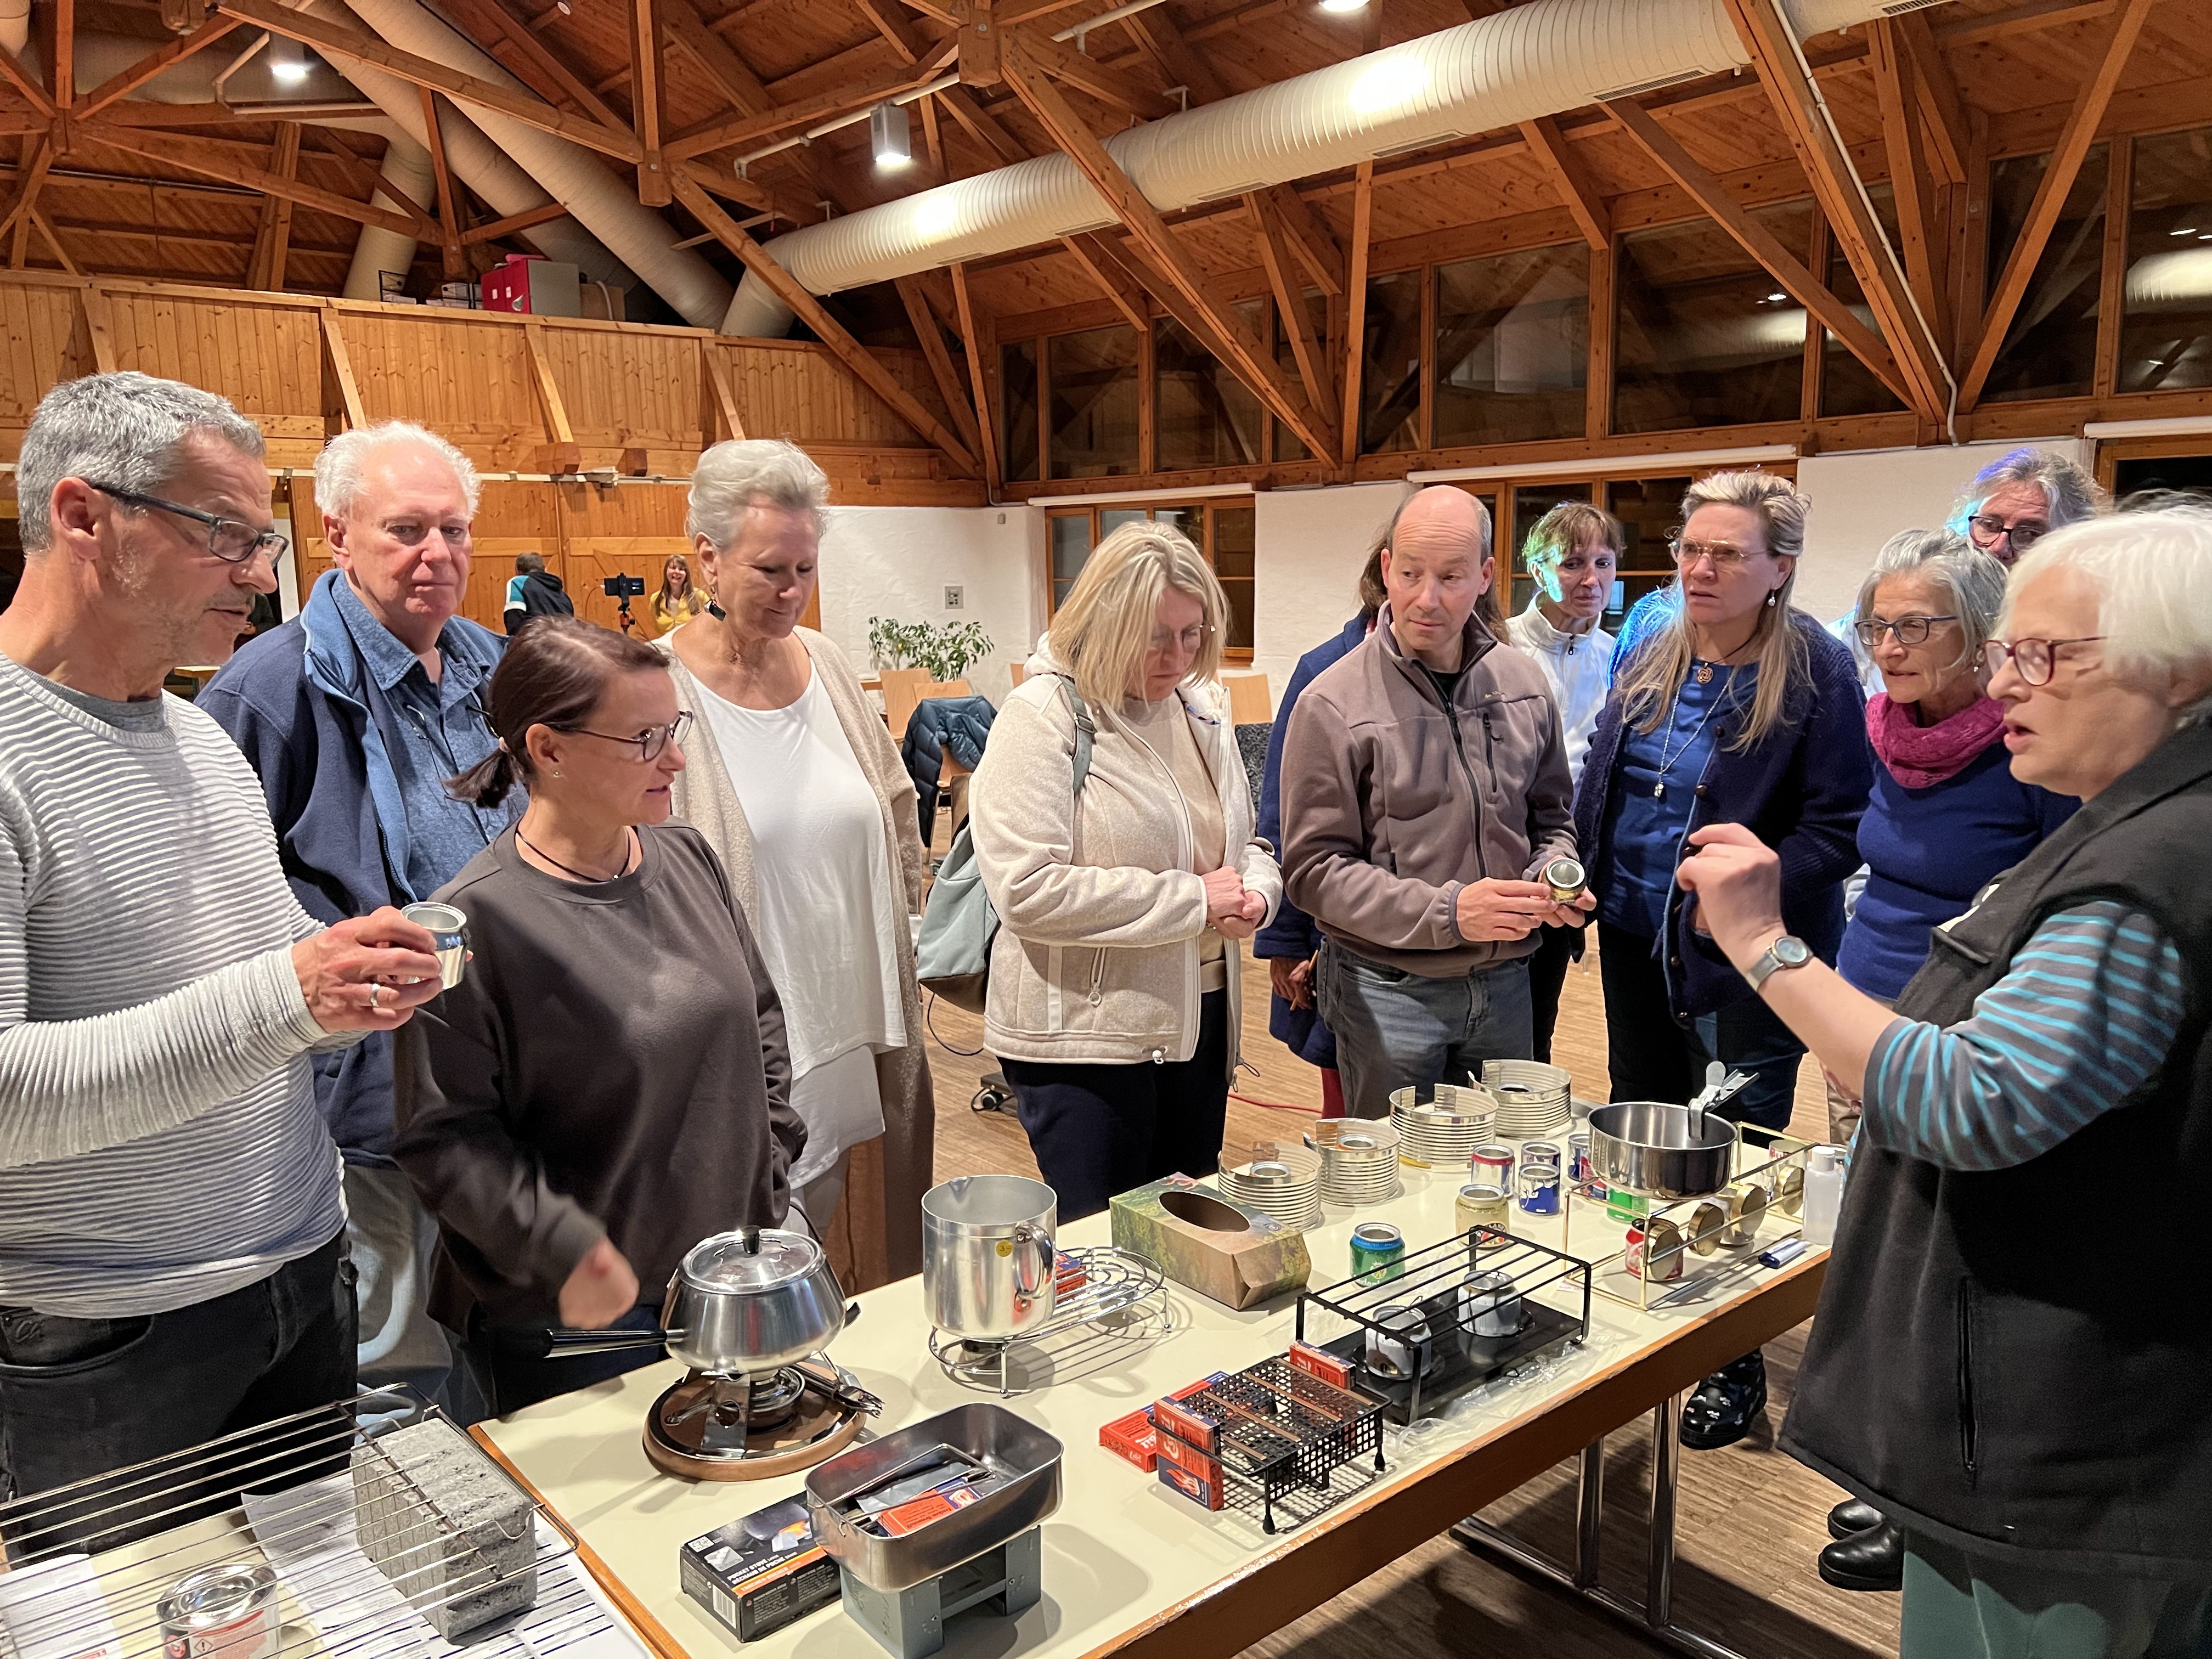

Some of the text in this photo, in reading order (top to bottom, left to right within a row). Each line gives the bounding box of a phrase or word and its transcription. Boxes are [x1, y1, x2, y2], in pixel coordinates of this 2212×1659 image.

[727, 1567, 750, 1580] POCKET
[749, 1559, 768, 1572] STOVE
[766, 1556, 786, 1568] POCHE
